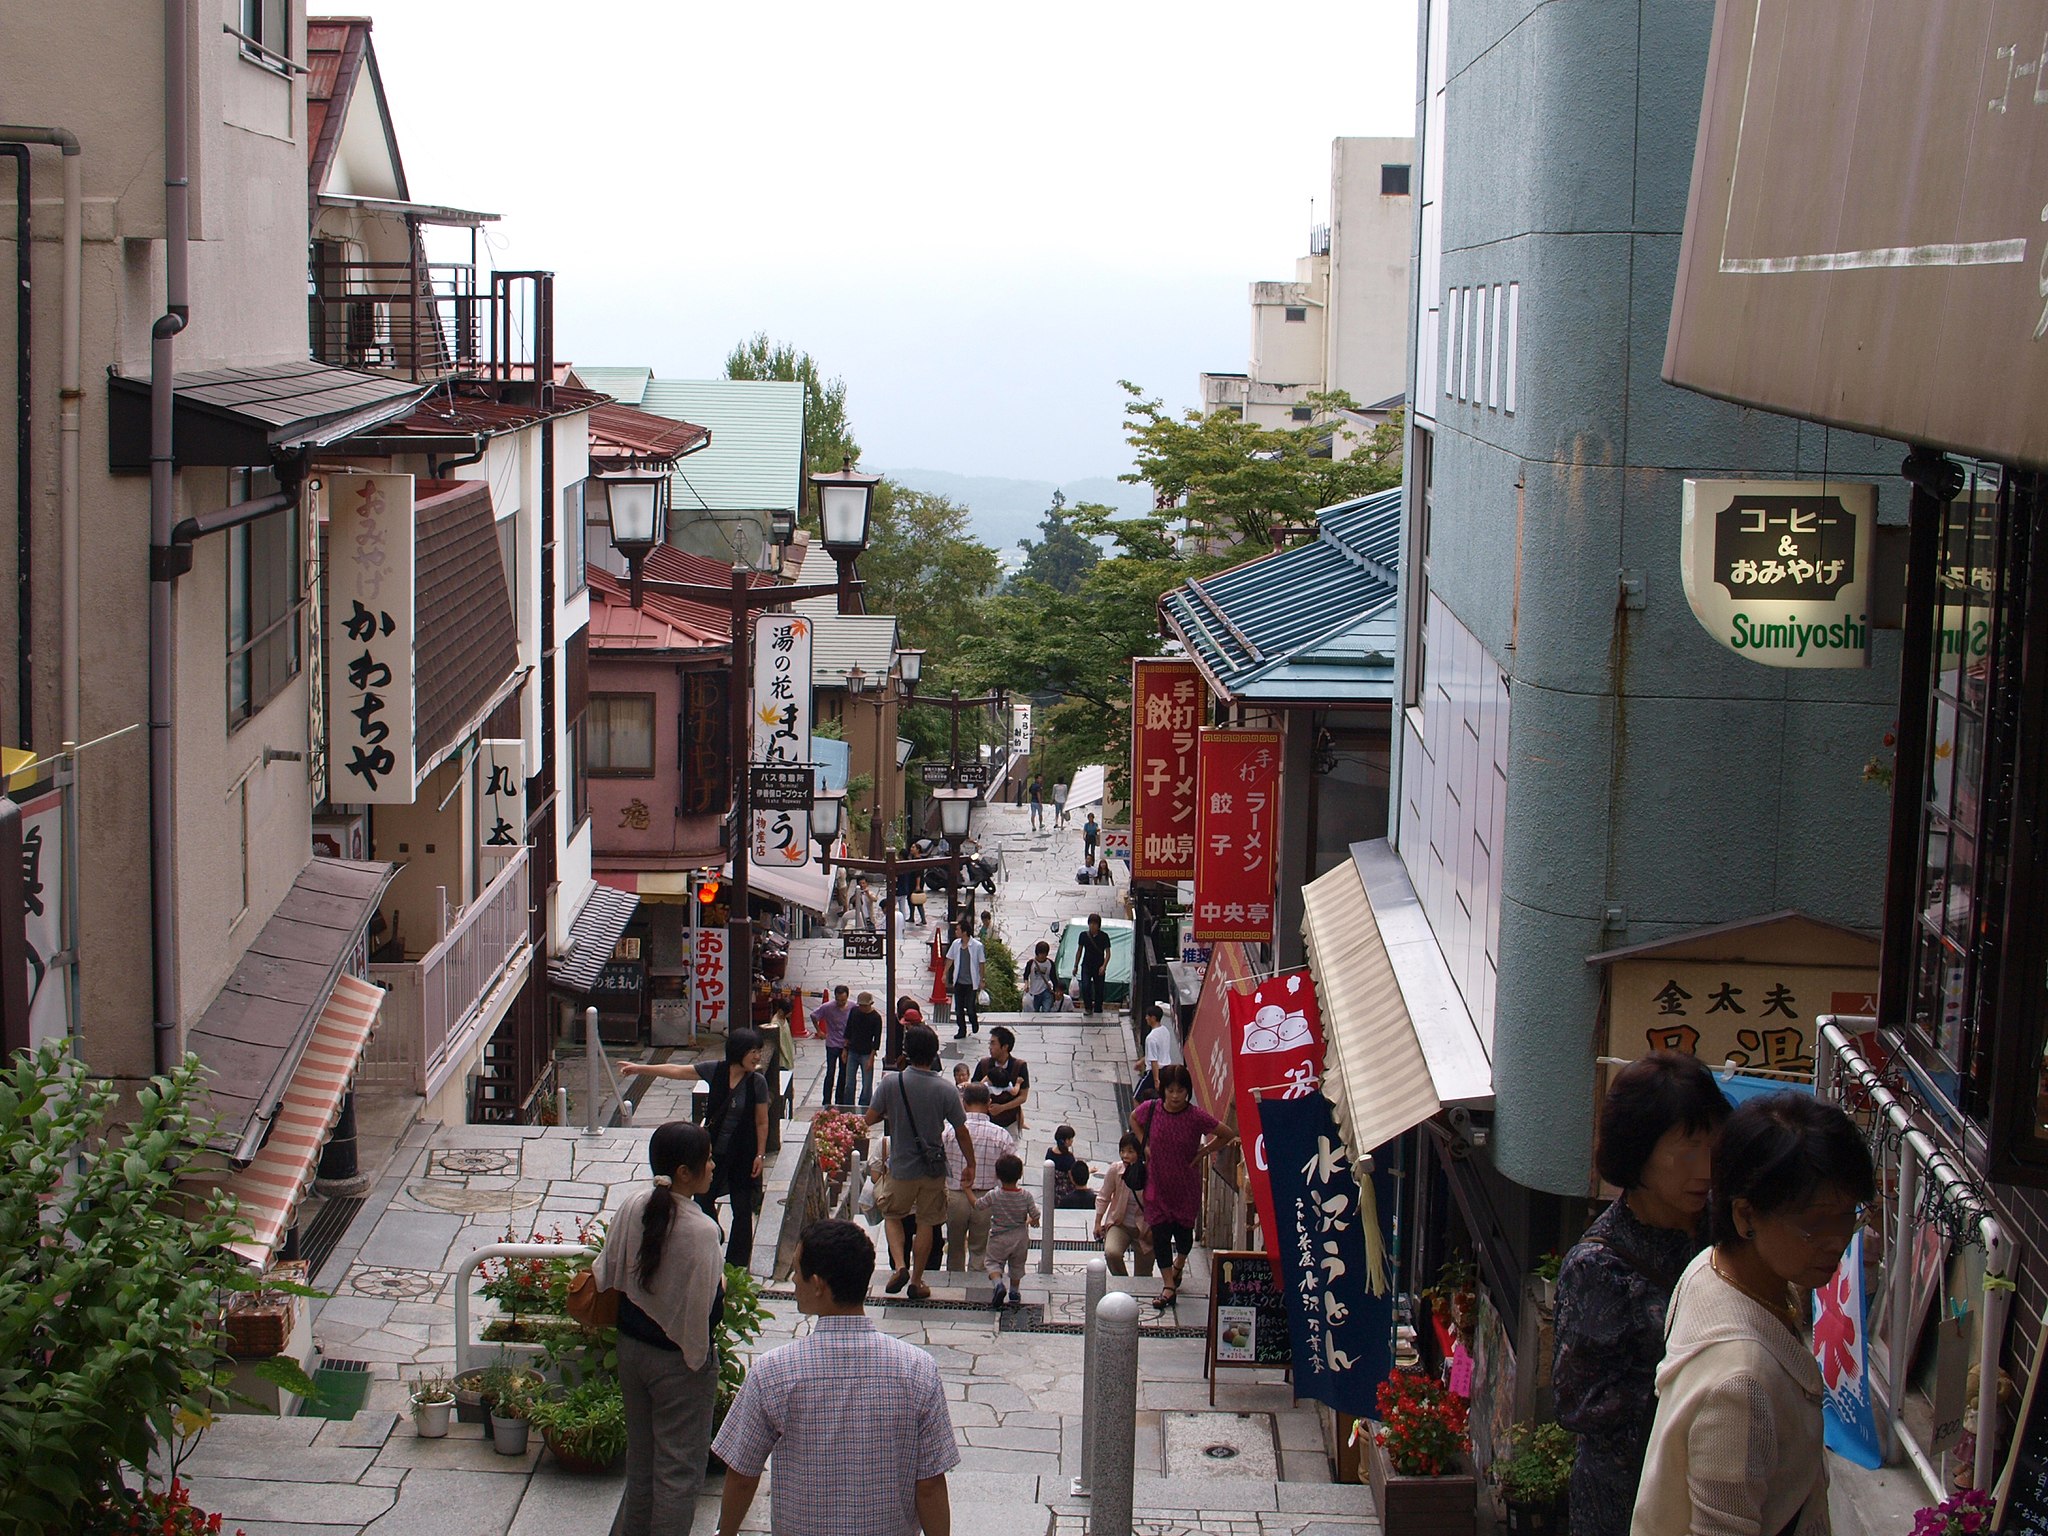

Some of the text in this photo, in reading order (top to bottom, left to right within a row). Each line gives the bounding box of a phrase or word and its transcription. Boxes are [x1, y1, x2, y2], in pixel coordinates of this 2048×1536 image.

[1739, 507, 1838, 534] コーヒー
[1778, 535, 1798, 557] &
[1731, 558, 1845, 586] おみやげ
[341, 479, 396, 792] おみやげ かわちや
[1731, 612, 1867, 658] Sumiyoshi
[766, 625, 799, 850] 湯の花まんう
[1143, 693, 1172, 797] 餃子
[1171, 678, 1196, 823] 手打ラーメン
[760, 773, 805, 783] バス発着所
[485, 765, 518, 848] 丸太
[1210, 791, 1234, 857] 餃子
[755, 808, 767, 857] 物産店
[1105, 834, 1128, 847] クス
[1144, 833, 1194, 865] 中央亭
[1242, 791, 1266, 873] ラーメン
[1200, 902, 1270, 925] 中央亭
[695, 930, 725, 1024] おみやげ
[1652, 979, 1798, 1019] 金太夫
[1300, 1135, 1362, 1373] 水沢うどん
